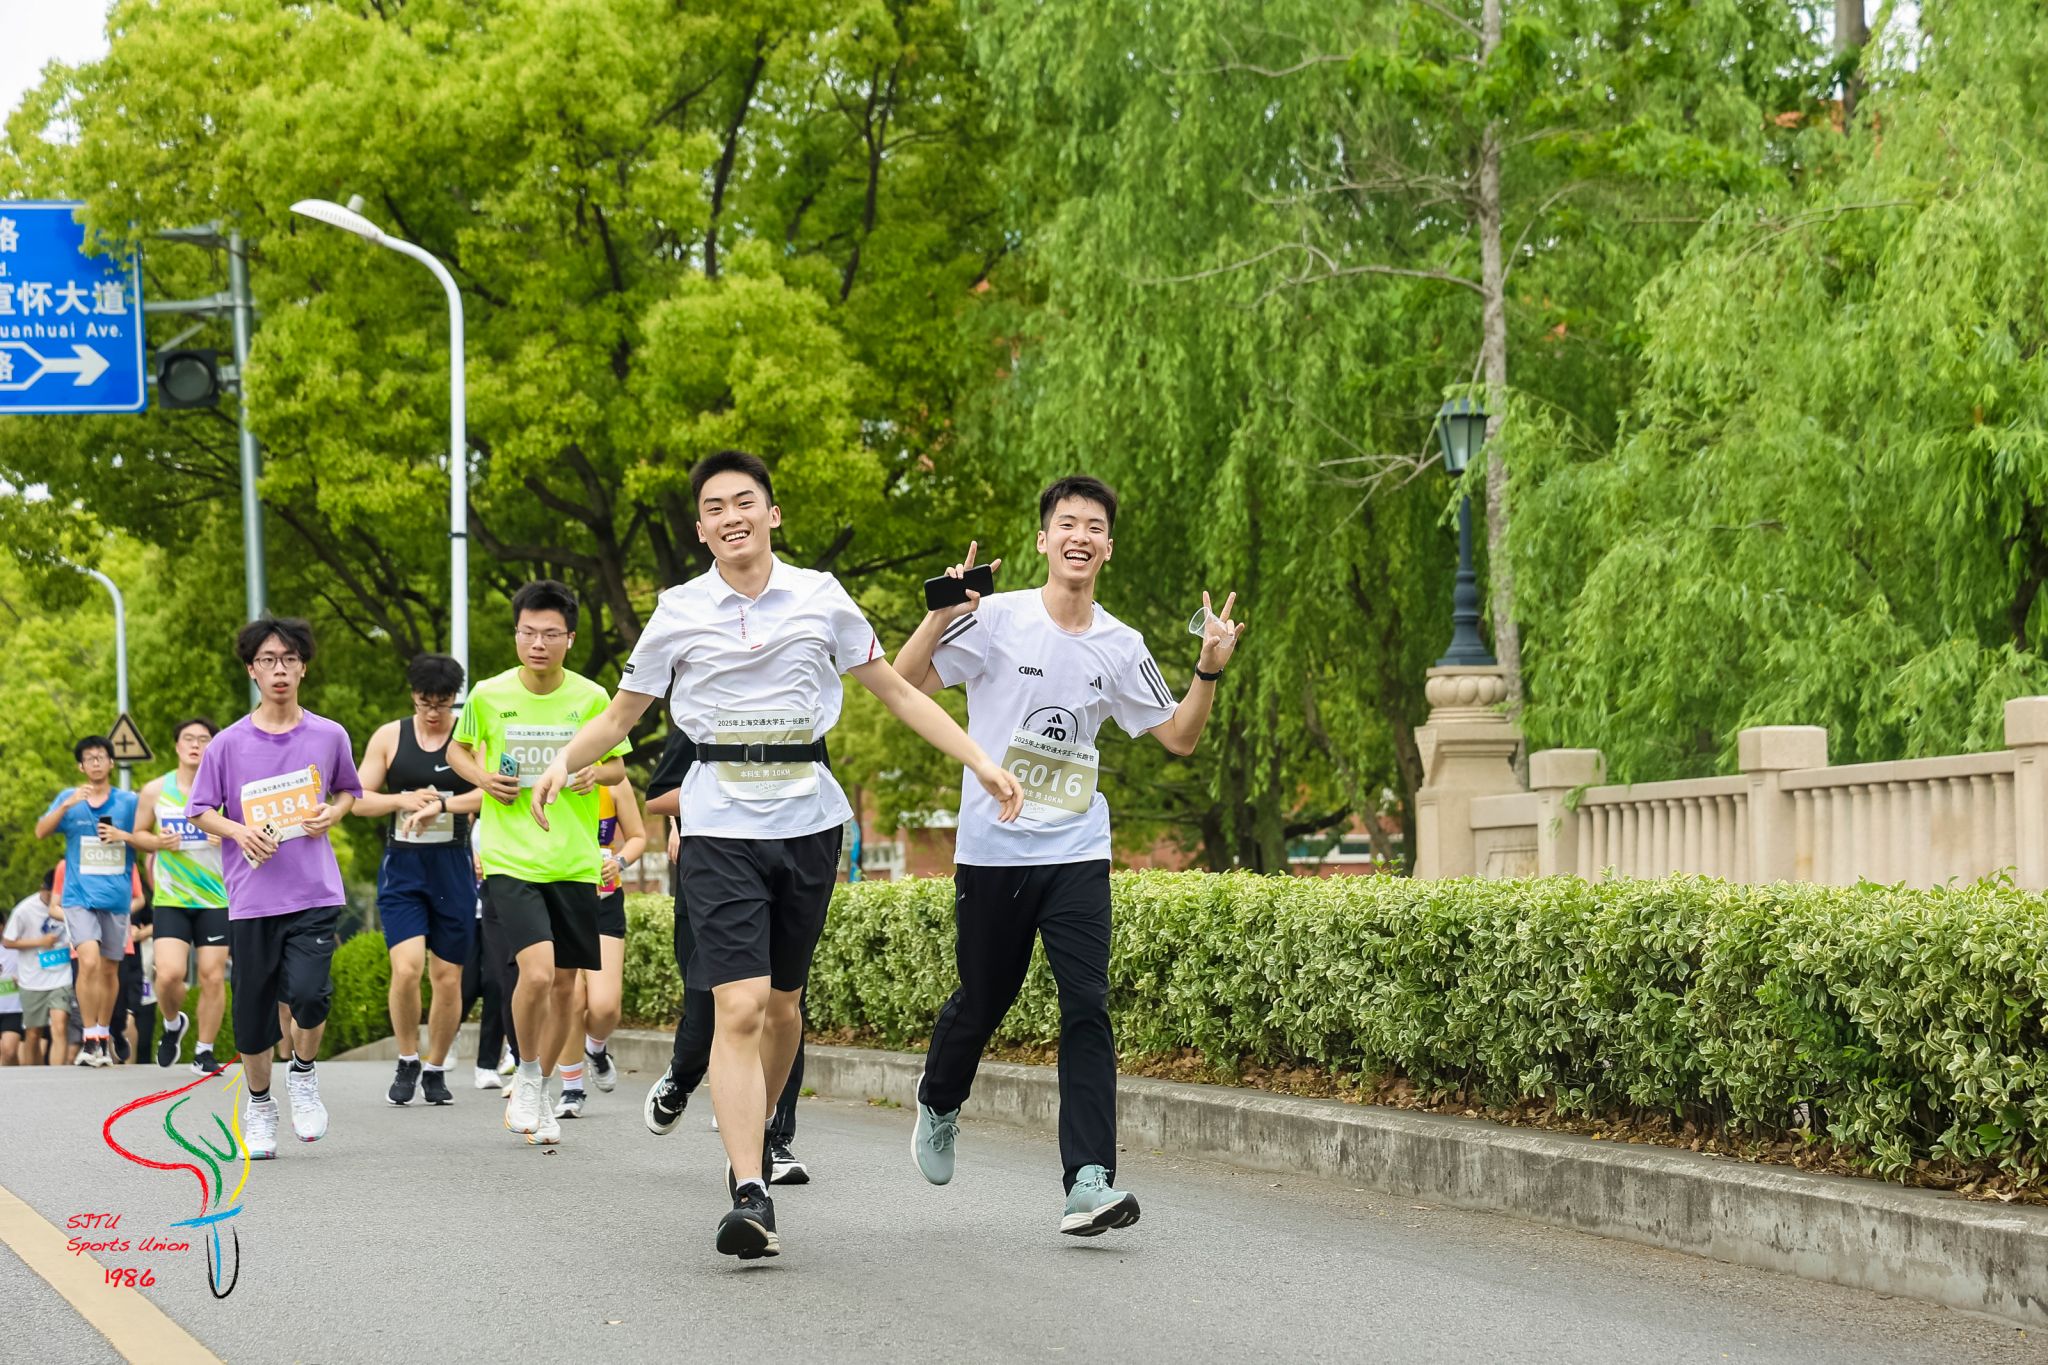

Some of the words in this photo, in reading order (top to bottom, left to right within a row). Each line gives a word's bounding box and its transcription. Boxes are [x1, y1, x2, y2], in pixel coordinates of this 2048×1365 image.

[86, 322, 123, 338] Ave.
[1018, 666, 1044, 678] CURA
[717, 717, 810, 727] 2025年上海交通大学五一长跑节
[512, 746, 563, 765] G00
[772, 769, 791, 777] 10KM
[1008, 758, 1083, 797] G016
[1044, 794, 1064, 804] 10KM
[251, 793, 310, 822] B184
[164, 822, 203, 834] A10
[85, 849, 121, 861] G043
